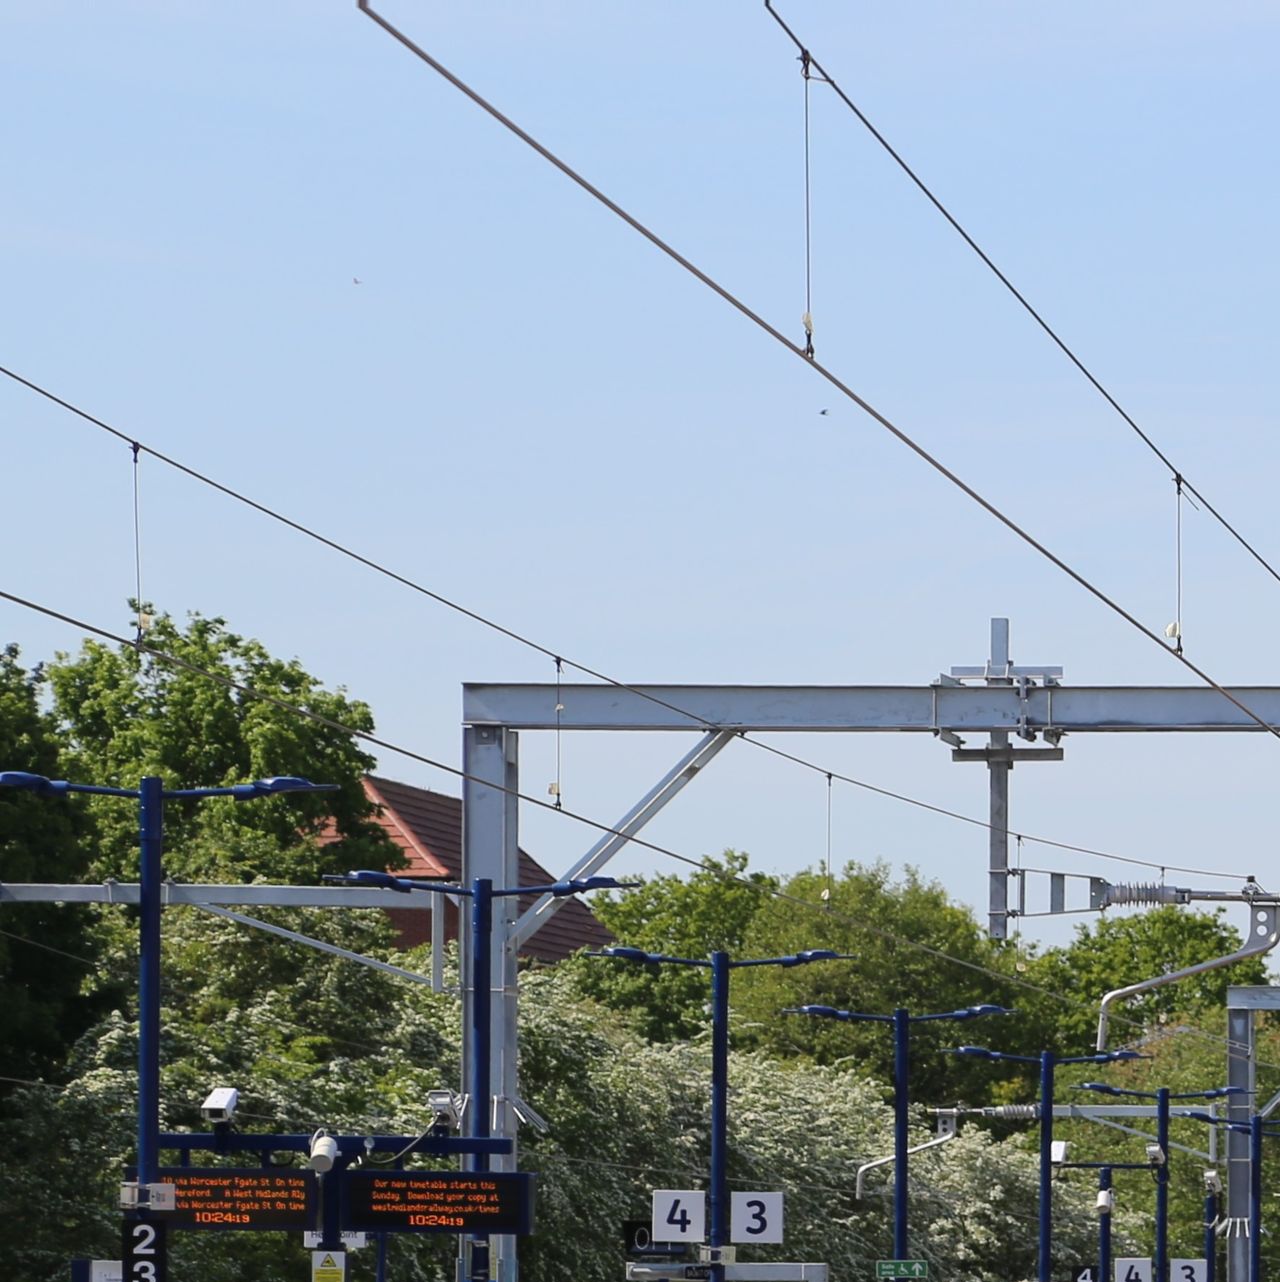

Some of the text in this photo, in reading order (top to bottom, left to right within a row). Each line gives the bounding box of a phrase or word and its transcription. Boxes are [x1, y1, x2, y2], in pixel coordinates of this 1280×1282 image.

[190, 1177, 231, 1186] Worcester
[235, 1177, 257, 1187] Fgate
[409, 1180, 447, 1189] timetable
[233, 1190, 252, 1198] West
[256, 1190, 289, 1198] Midlands
[407, 1191, 444, 1200] Download
[191, 1201, 232, 1209] Worcester
[236, 1201, 260, 1211] Fgate
[194, 1211, 250, 1223] 10:24:19
[409, 1215, 464, 1226] 10:24:19
[666, 1199, 692, 1233] 4
[746, 1200, 767, 1235] 3
[132, 1224, 156, 1254] 2
